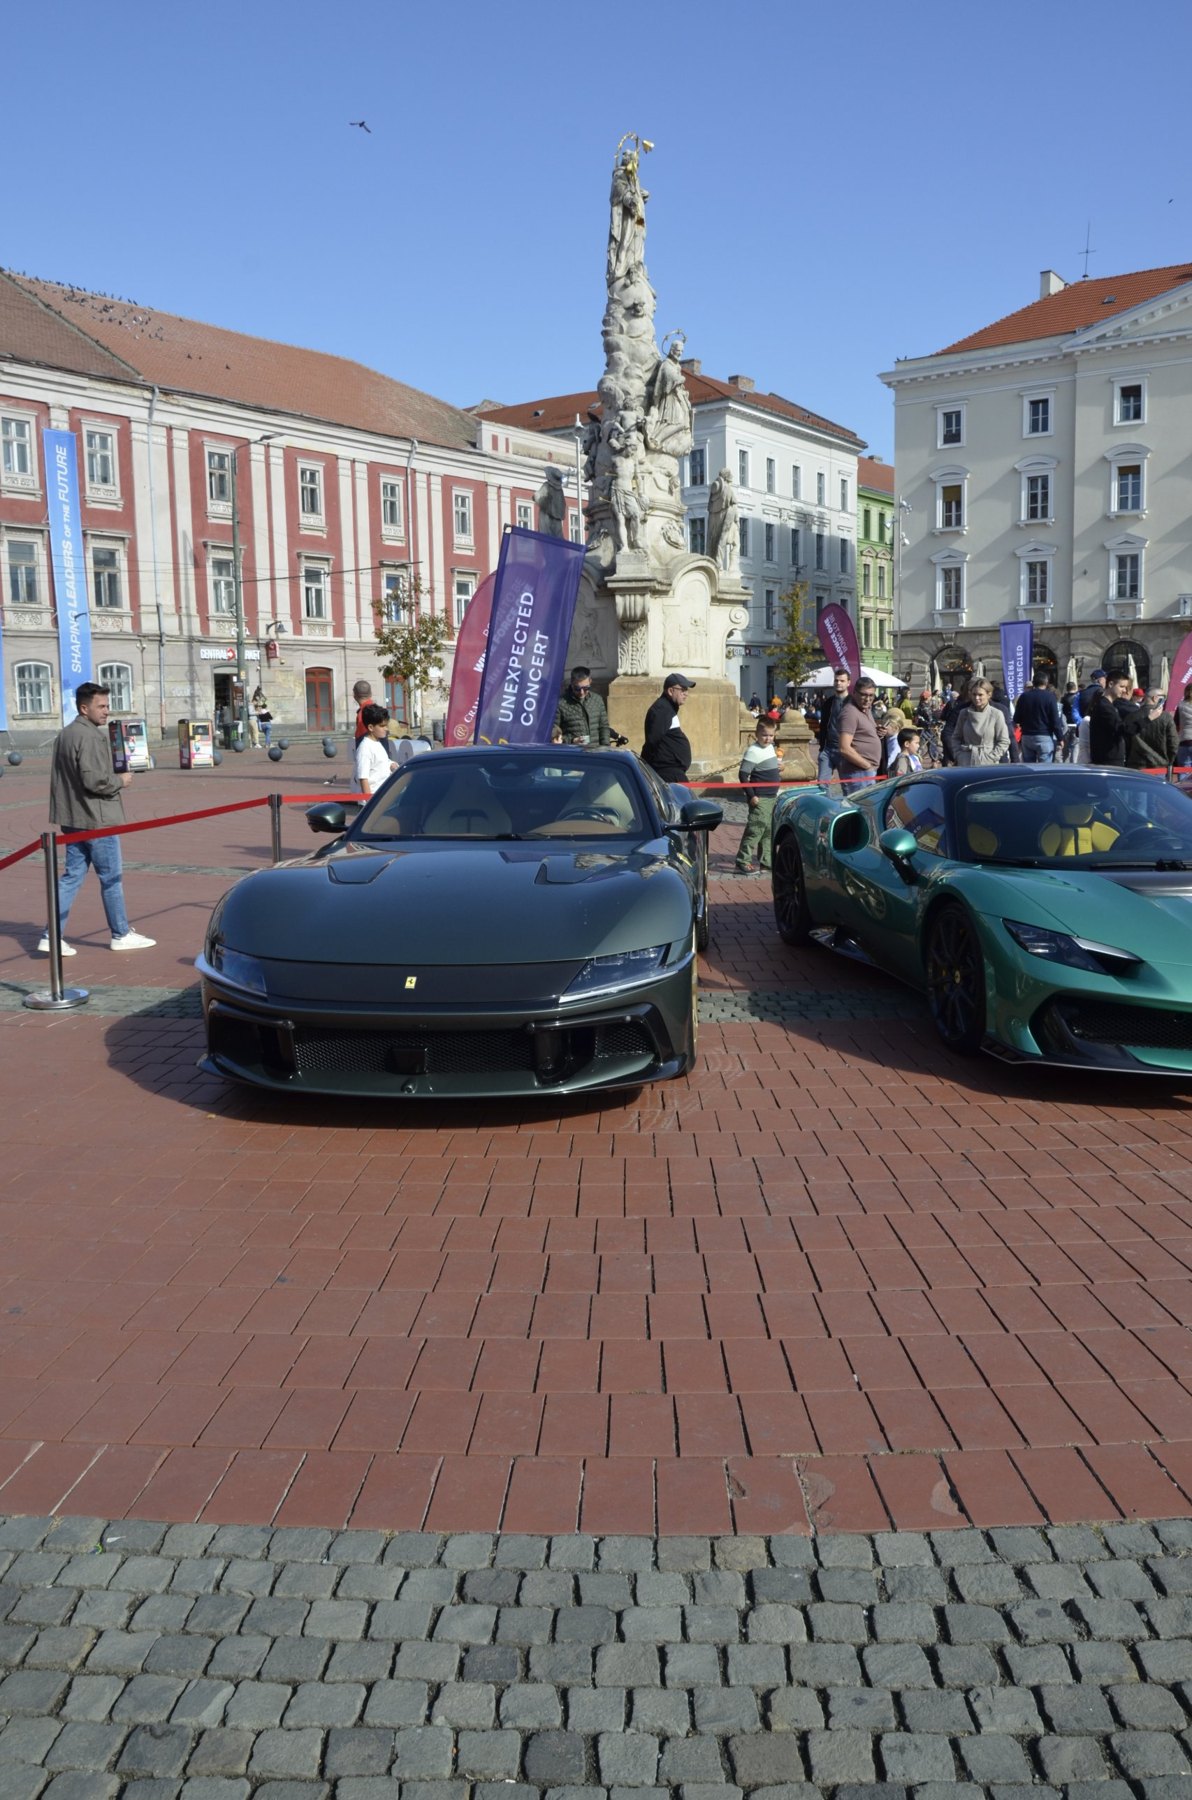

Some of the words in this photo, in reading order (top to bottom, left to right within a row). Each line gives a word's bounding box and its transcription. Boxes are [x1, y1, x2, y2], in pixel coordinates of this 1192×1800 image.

[56, 444, 70, 503] FUTURE
[62, 504, 71, 521] THE
[64, 521, 72, 538] OF
[62, 540, 78, 609] LEADERS
[69, 610, 82, 674] SHAPING
[200, 648, 227, 660] CENTRAL
[498, 592, 534, 722] UNEXPECTED
[520, 629, 549, 726] CONCERT
